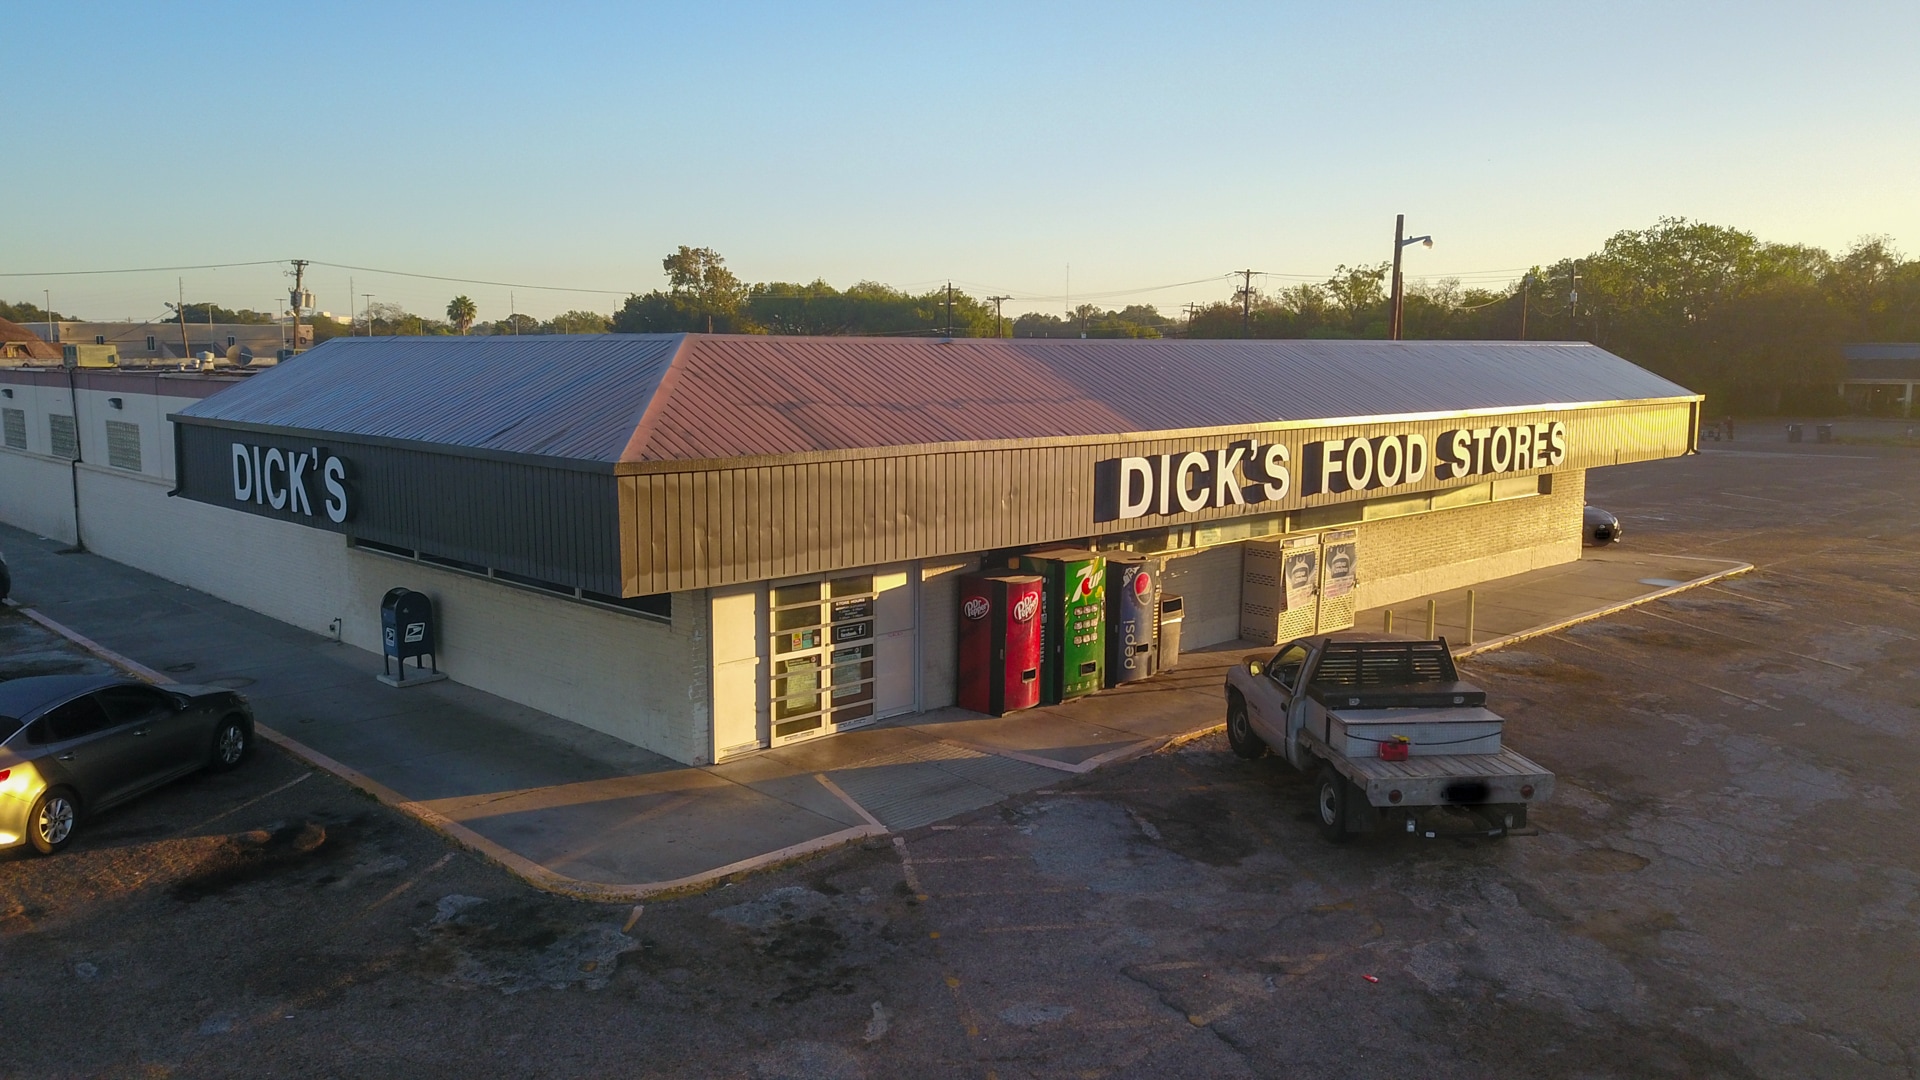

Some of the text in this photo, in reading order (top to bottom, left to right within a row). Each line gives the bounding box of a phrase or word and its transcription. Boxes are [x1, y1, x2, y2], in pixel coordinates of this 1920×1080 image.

[1119, 421, 1567, 519] DICK'S FOOD STORES
[232, 443, 347, 523] DICK'S
[967, 602, 987, 617] Pepper
[972, 598, 982, 609] Dr
[1017, 599, 1038, 620] Pepper
[1024, 595, 1034, 605] Dr
[1123, 619, 1137, 669] pepsi
